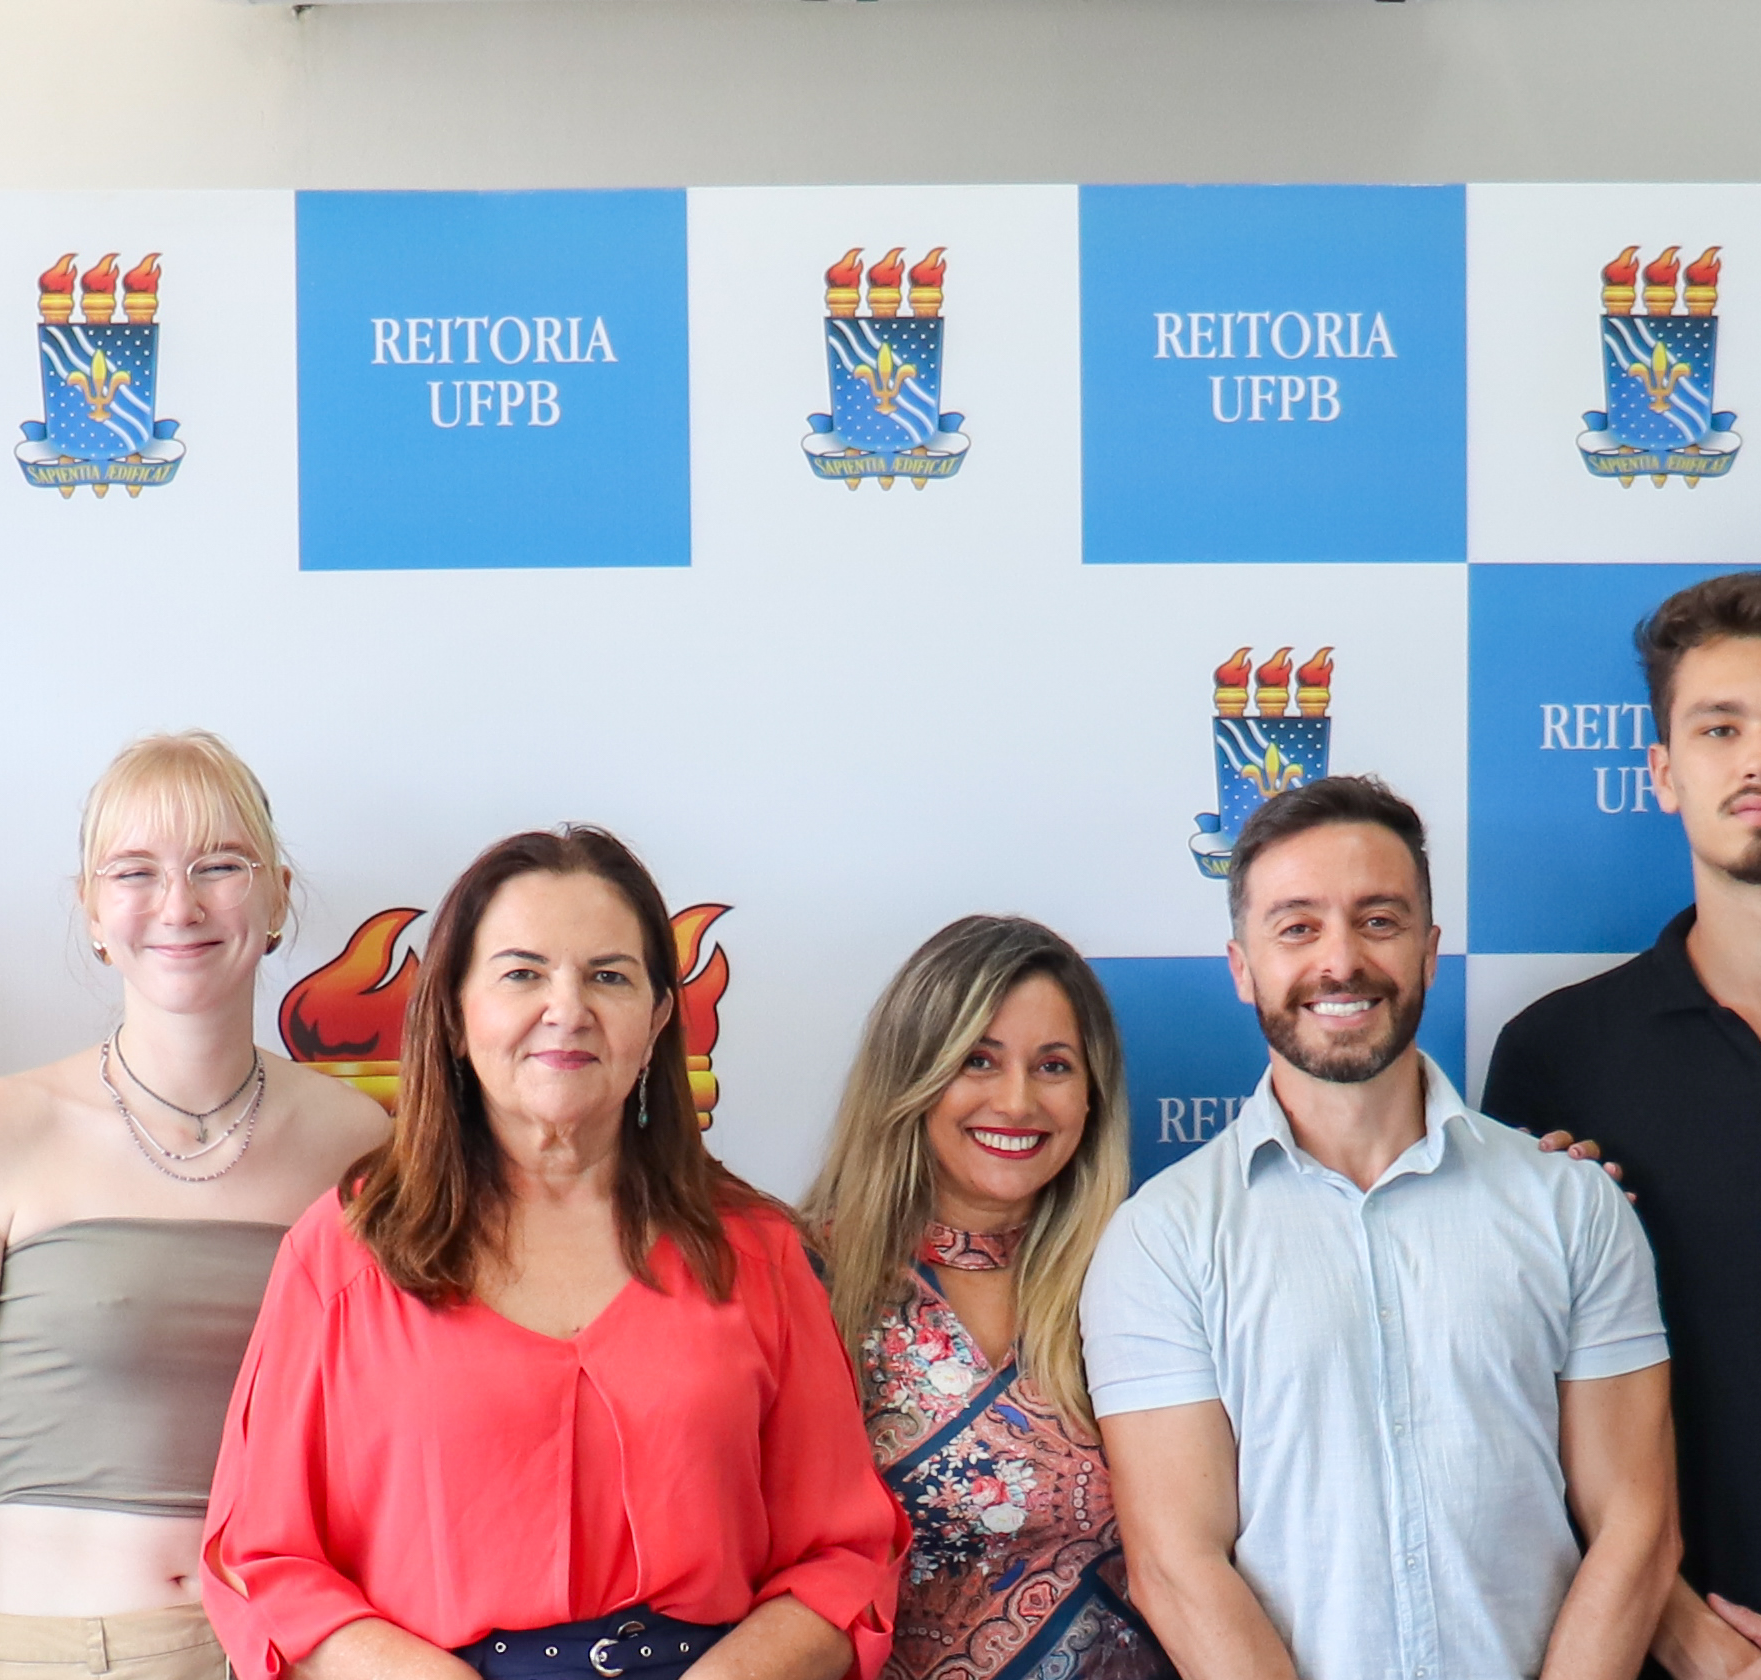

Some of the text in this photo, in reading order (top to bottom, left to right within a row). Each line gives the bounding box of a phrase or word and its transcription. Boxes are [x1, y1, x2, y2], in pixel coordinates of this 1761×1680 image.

[371, 316, 618, 364] REITORIA
[1154, 311, 1397, 359] REITORIA
[427, 380, 561, 428] UFPB
[1209, 376, 1341, 422] UFPB
[1540, 703, 1652, 750] REIT
[1593, 767, 1655, 814] UF
